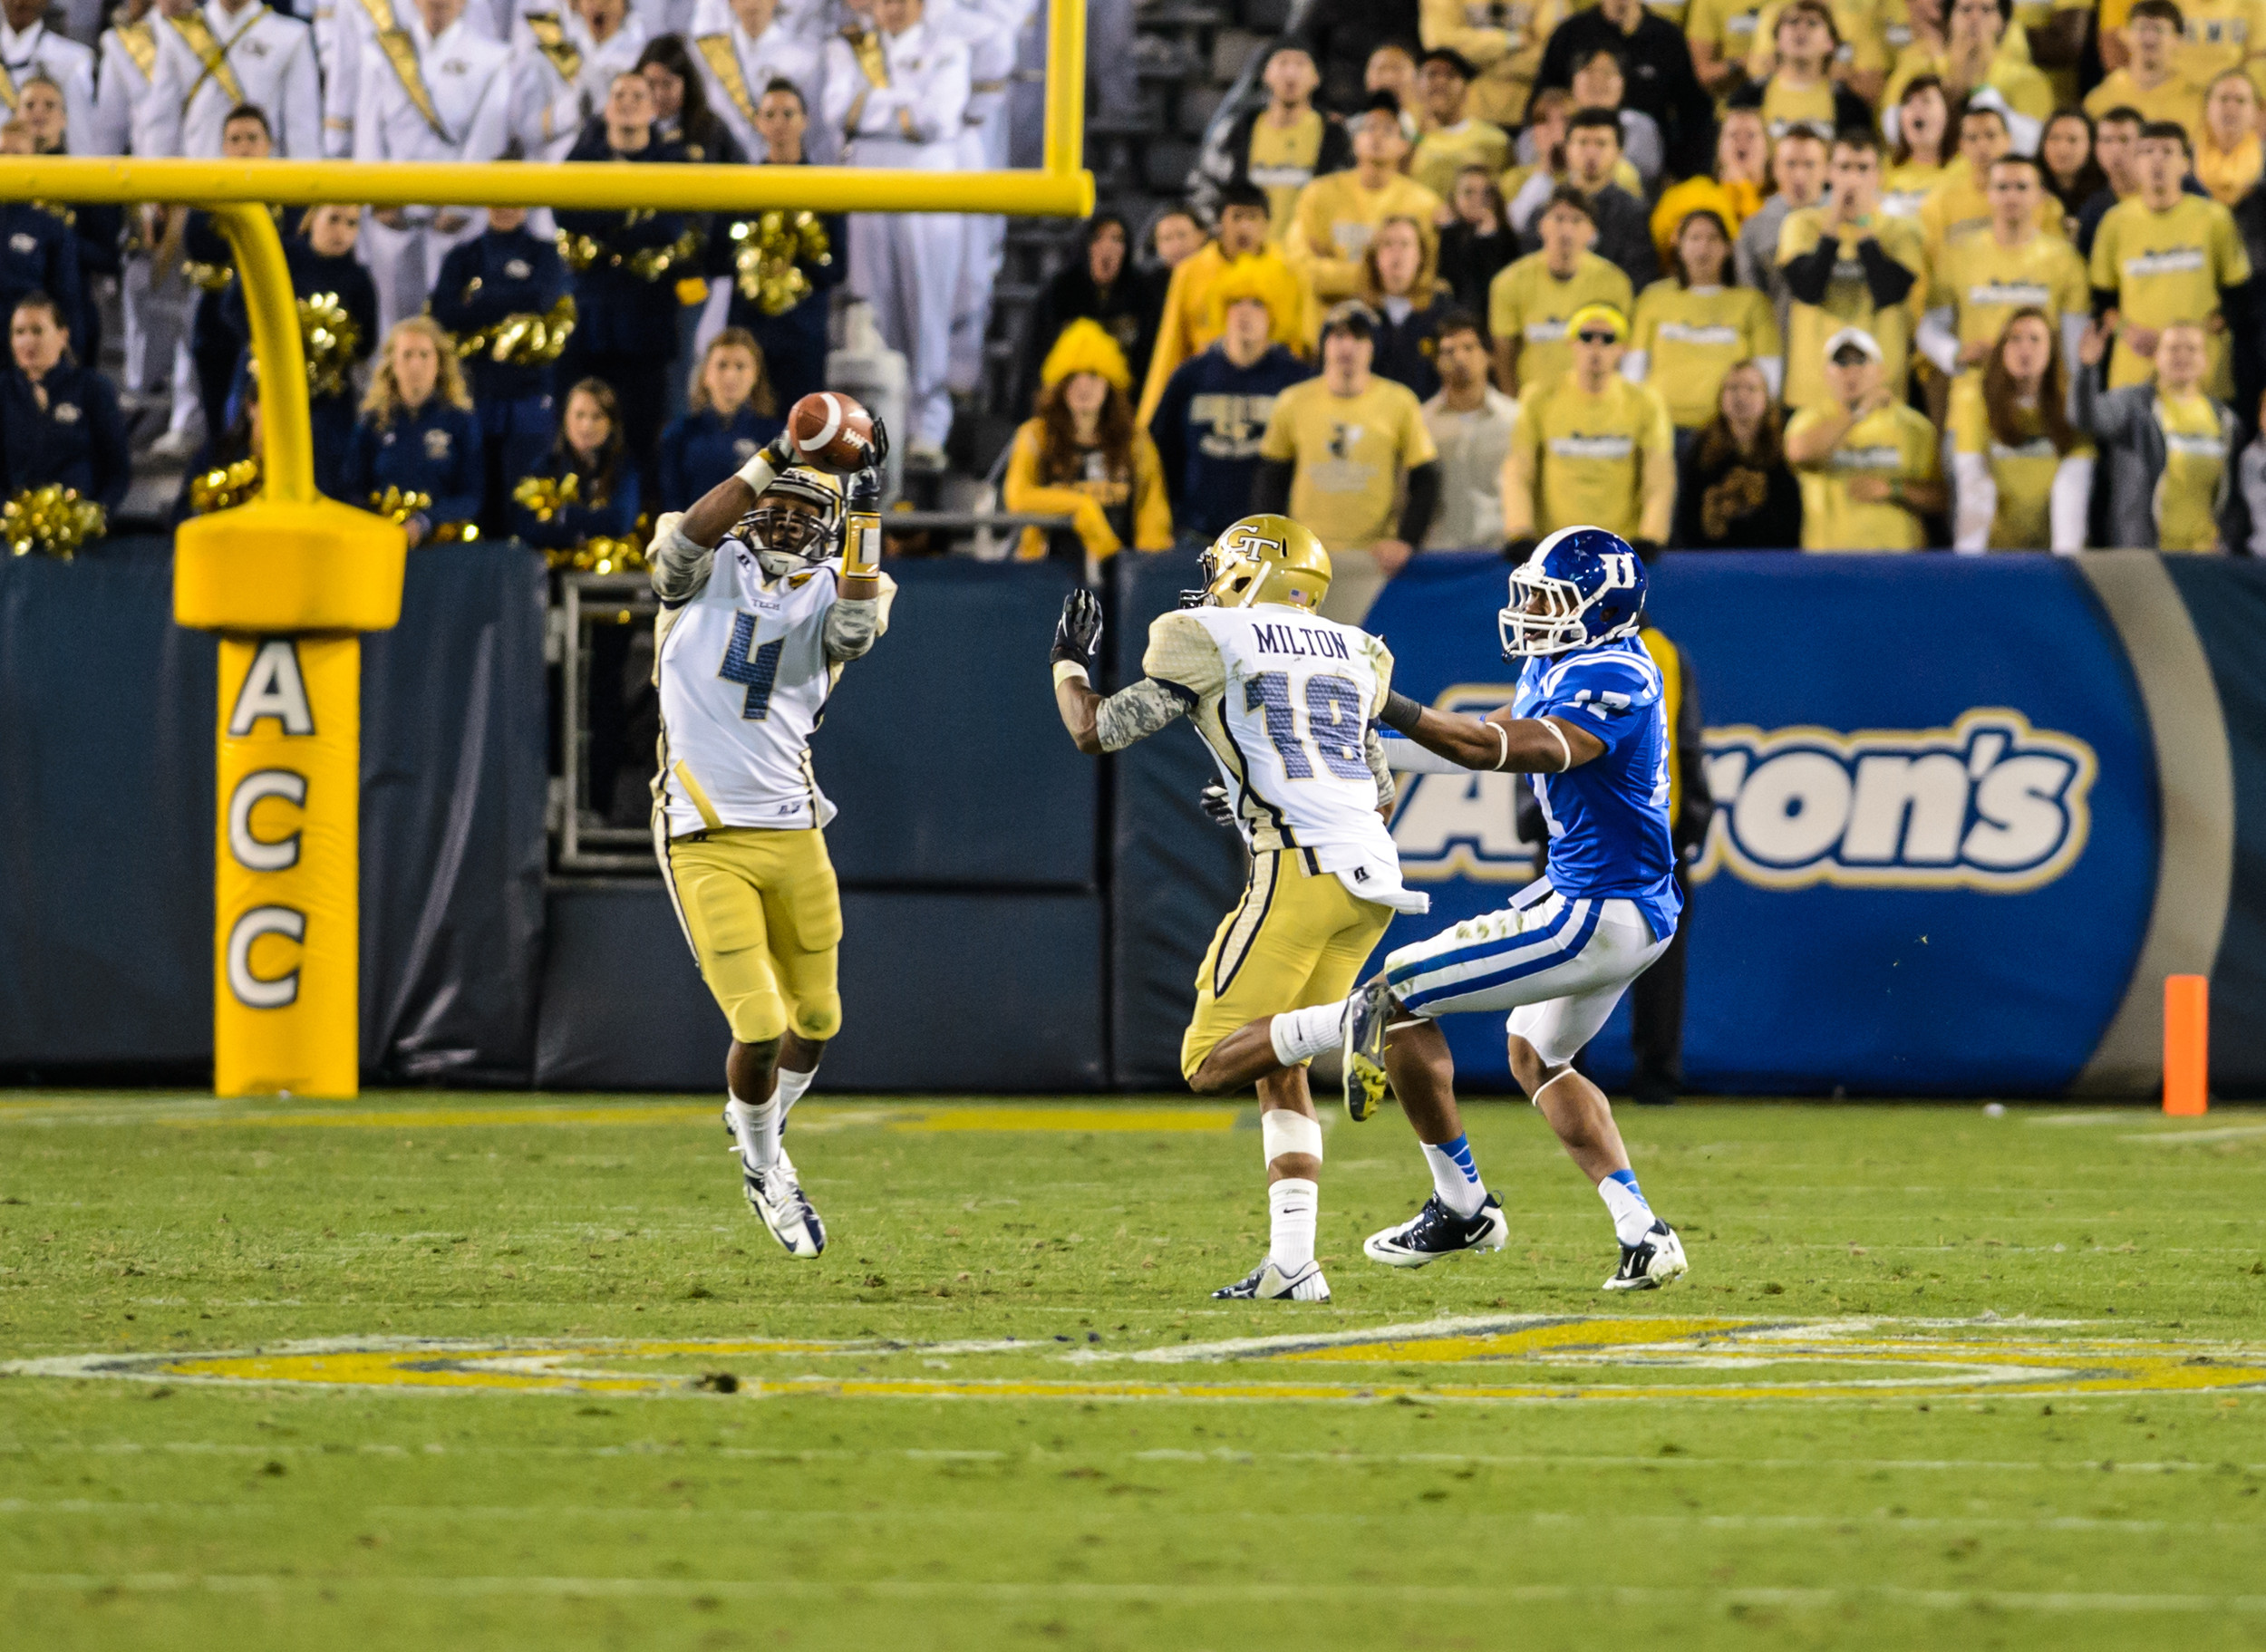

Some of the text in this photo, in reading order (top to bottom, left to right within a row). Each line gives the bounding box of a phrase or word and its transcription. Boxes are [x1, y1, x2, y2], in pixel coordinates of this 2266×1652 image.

[716, 608, 785, 721] 4
[1252, 623, 1350, 661] MILTON
[1243, 671, 1374, 783] 18
[227, 636, 316, 1010] ACC
[1390, 707, 2077, 871] Aon's
